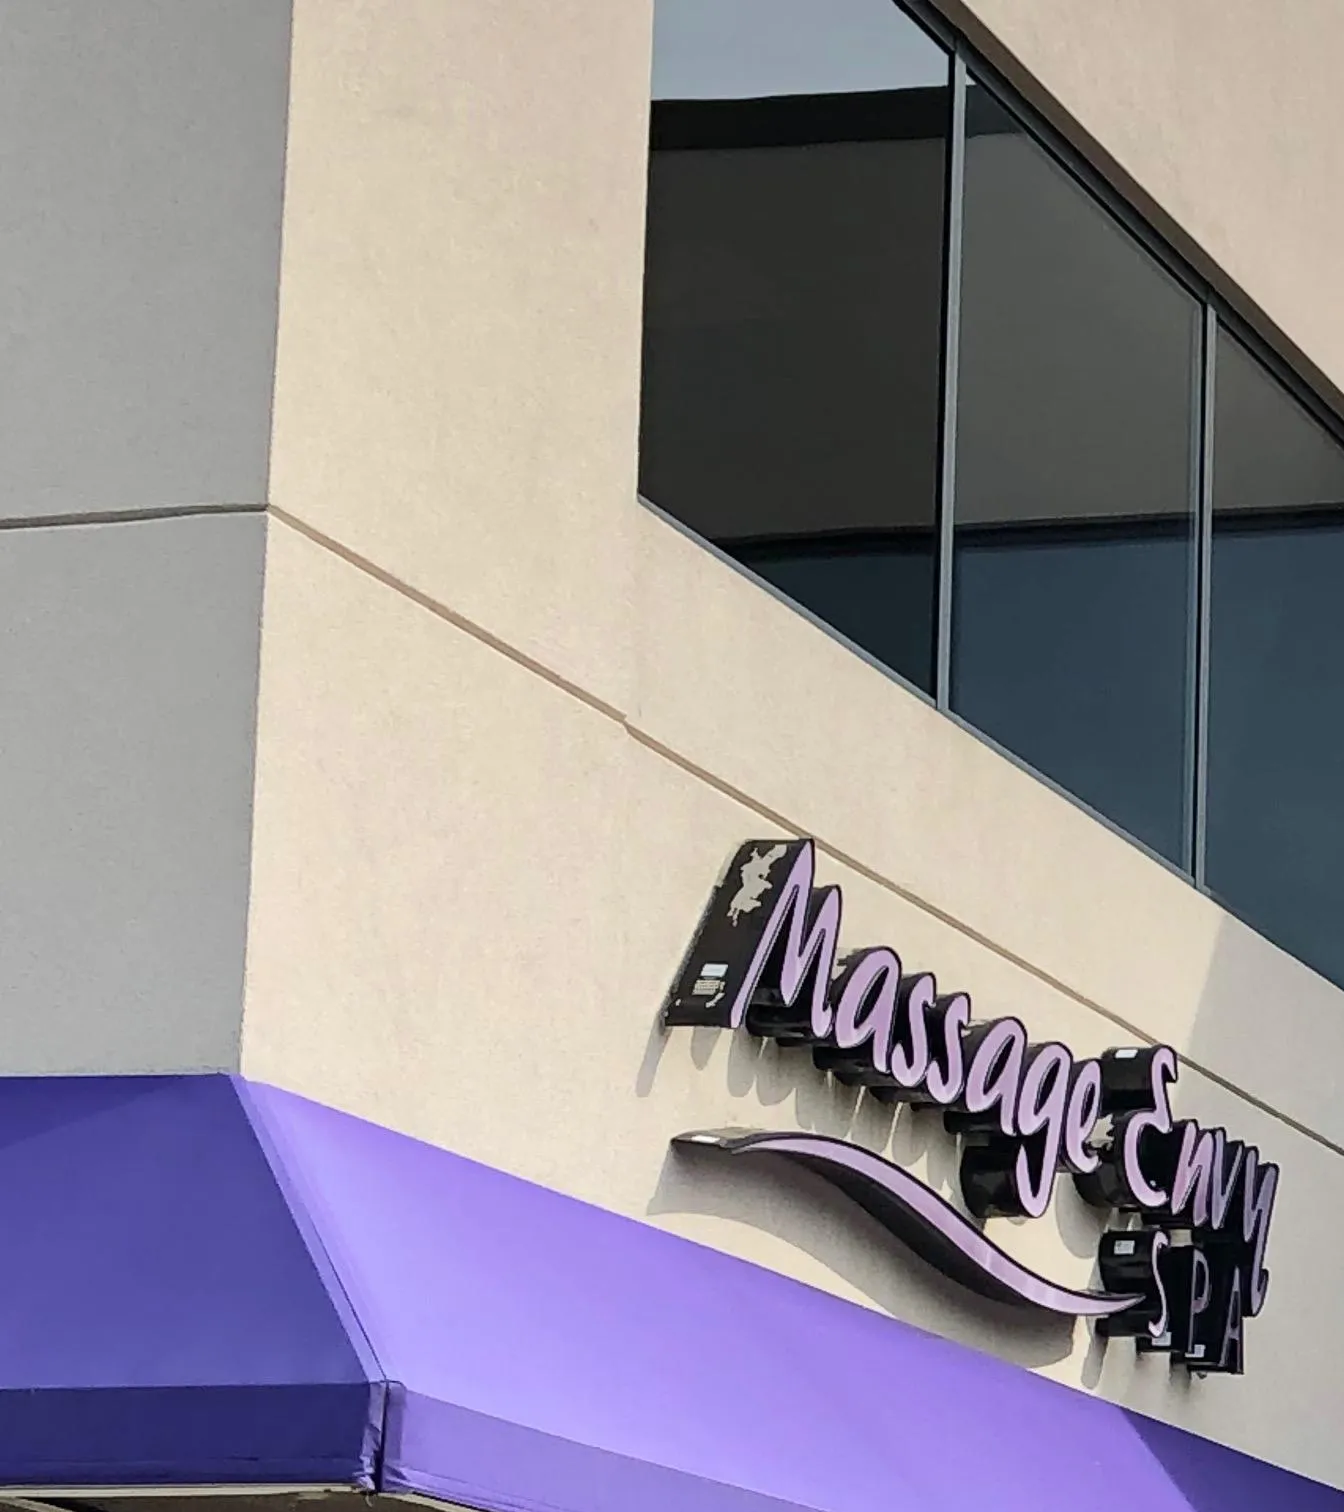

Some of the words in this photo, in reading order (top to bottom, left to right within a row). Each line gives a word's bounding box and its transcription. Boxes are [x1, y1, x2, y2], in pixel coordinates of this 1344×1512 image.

[730, 838, 1100, 1218] Massage
[1124, 1044, 1280, 1317] Envy
[1148, 1230, 1244, 1375] SPA
